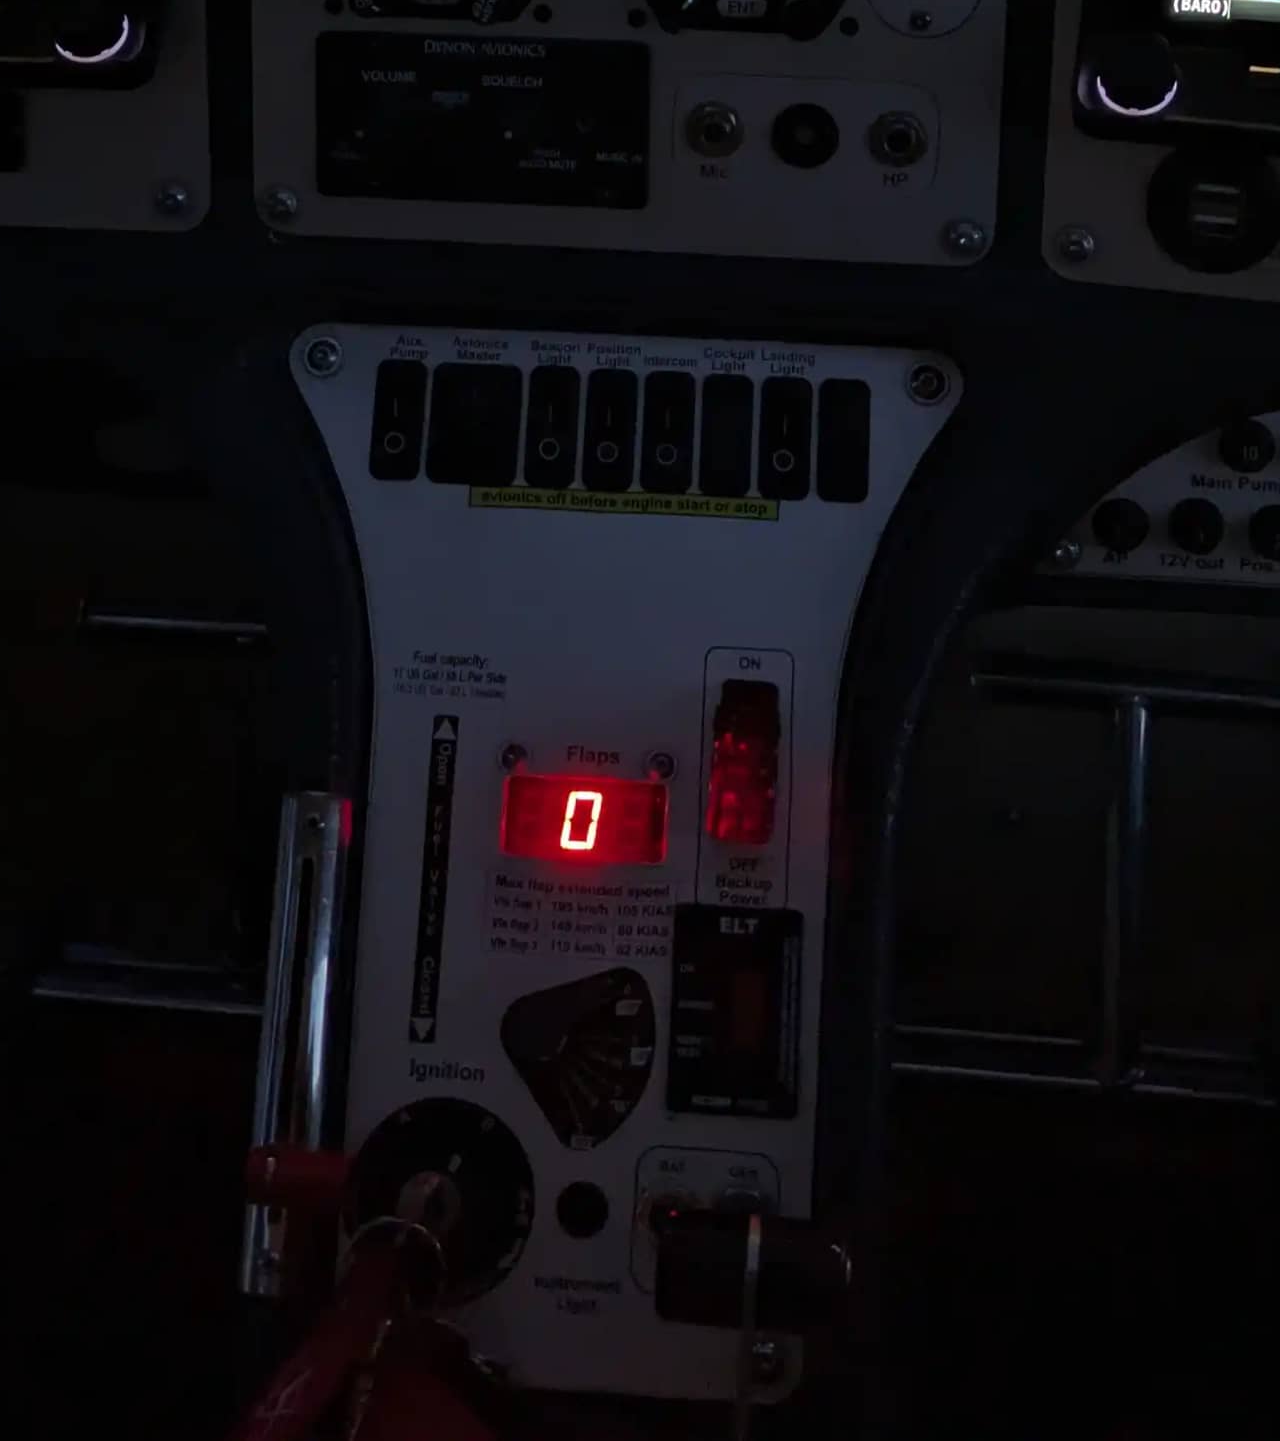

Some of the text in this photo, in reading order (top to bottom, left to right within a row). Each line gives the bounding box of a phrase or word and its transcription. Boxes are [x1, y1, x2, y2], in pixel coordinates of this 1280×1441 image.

[1191, 475, 1233, 490] Main
[739, 657, 761, 670] ON
[567, 746, 620, 766] Flaps
[560, 790, 603, 850] 0
[719, 918, 758, 934] ELT
[409, 1060, 485, 1084] Ignition
